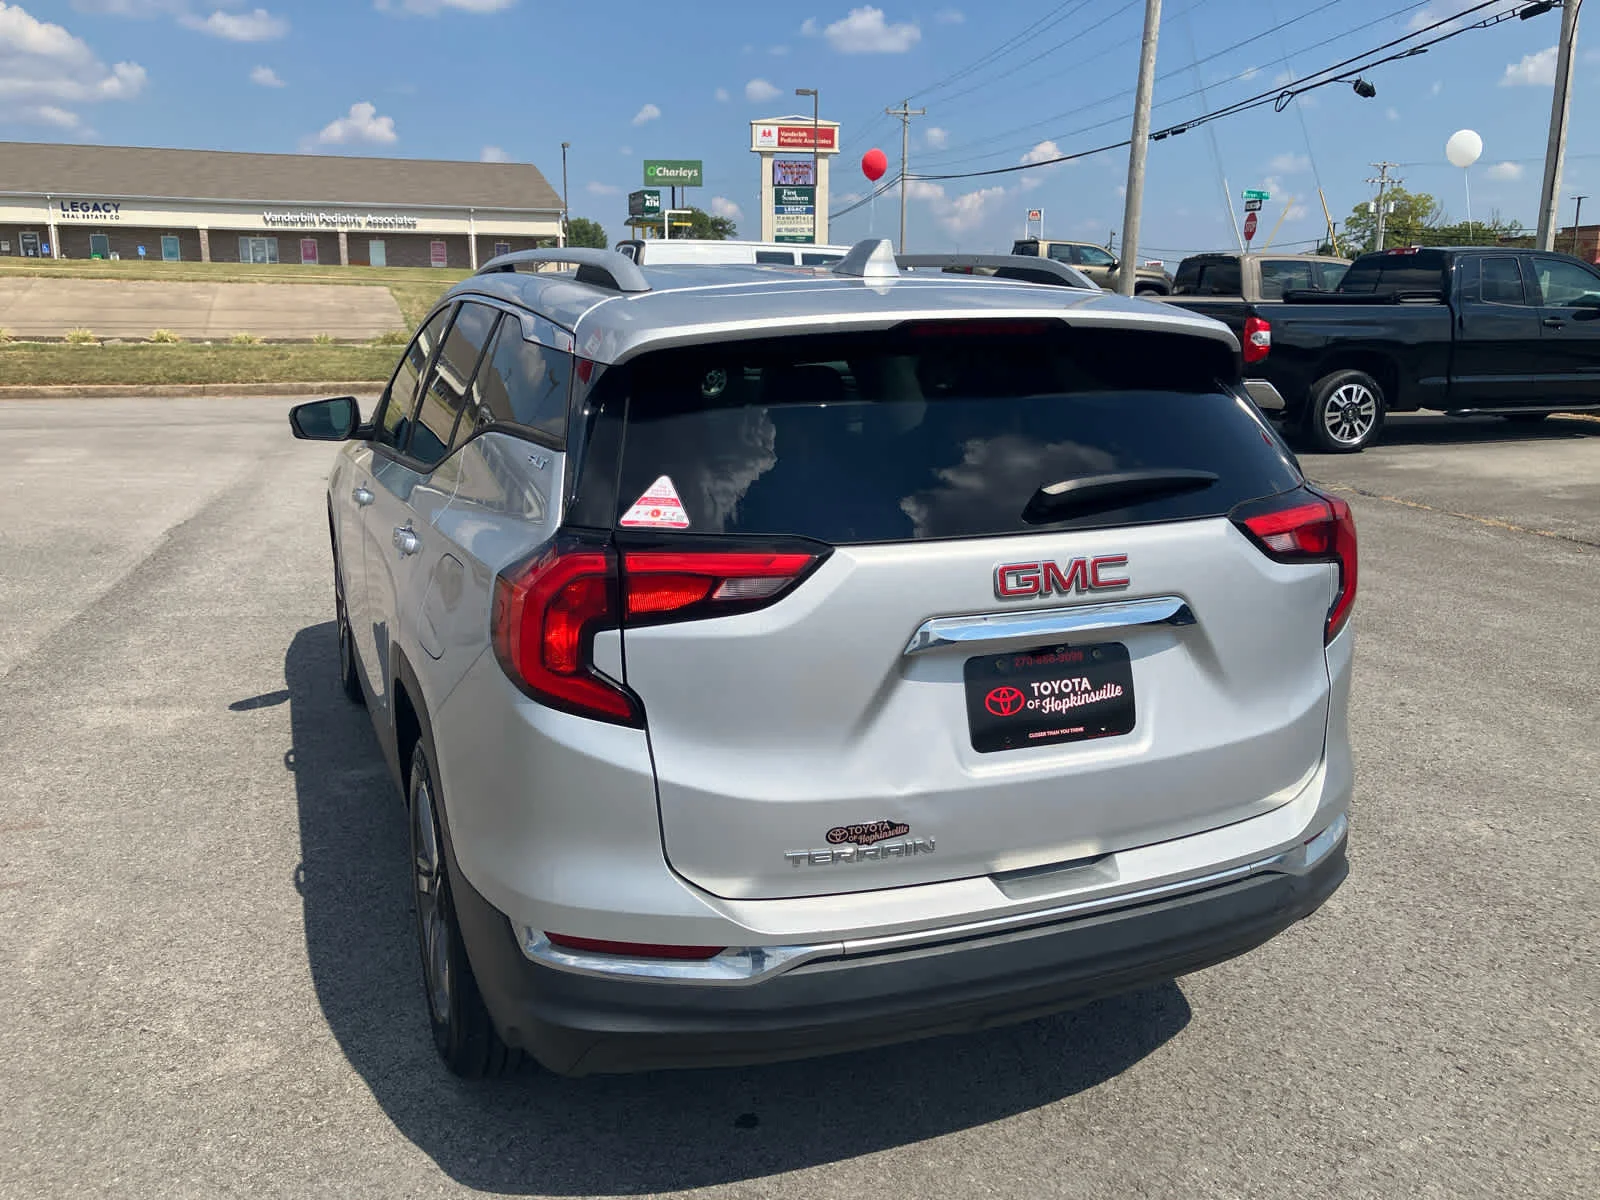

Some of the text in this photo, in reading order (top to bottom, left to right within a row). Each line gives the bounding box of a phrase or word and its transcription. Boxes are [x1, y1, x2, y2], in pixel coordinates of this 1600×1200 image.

[60, 200, 120, 213] LEGACY
[263, 211, 417, 225] Vanderbilt Pediatric Associates
[993, 553, 1130, 599] GMC
[1030, 677, 1092, 697] TOYOTA
[1027, 683, 1123, 715] OF Hopkinsville
[848, 822, 890, 835] TOYOTA
[858, 825, 909, 844] Hopkinsville
[784, 838, 936, 868] TERRAIN
